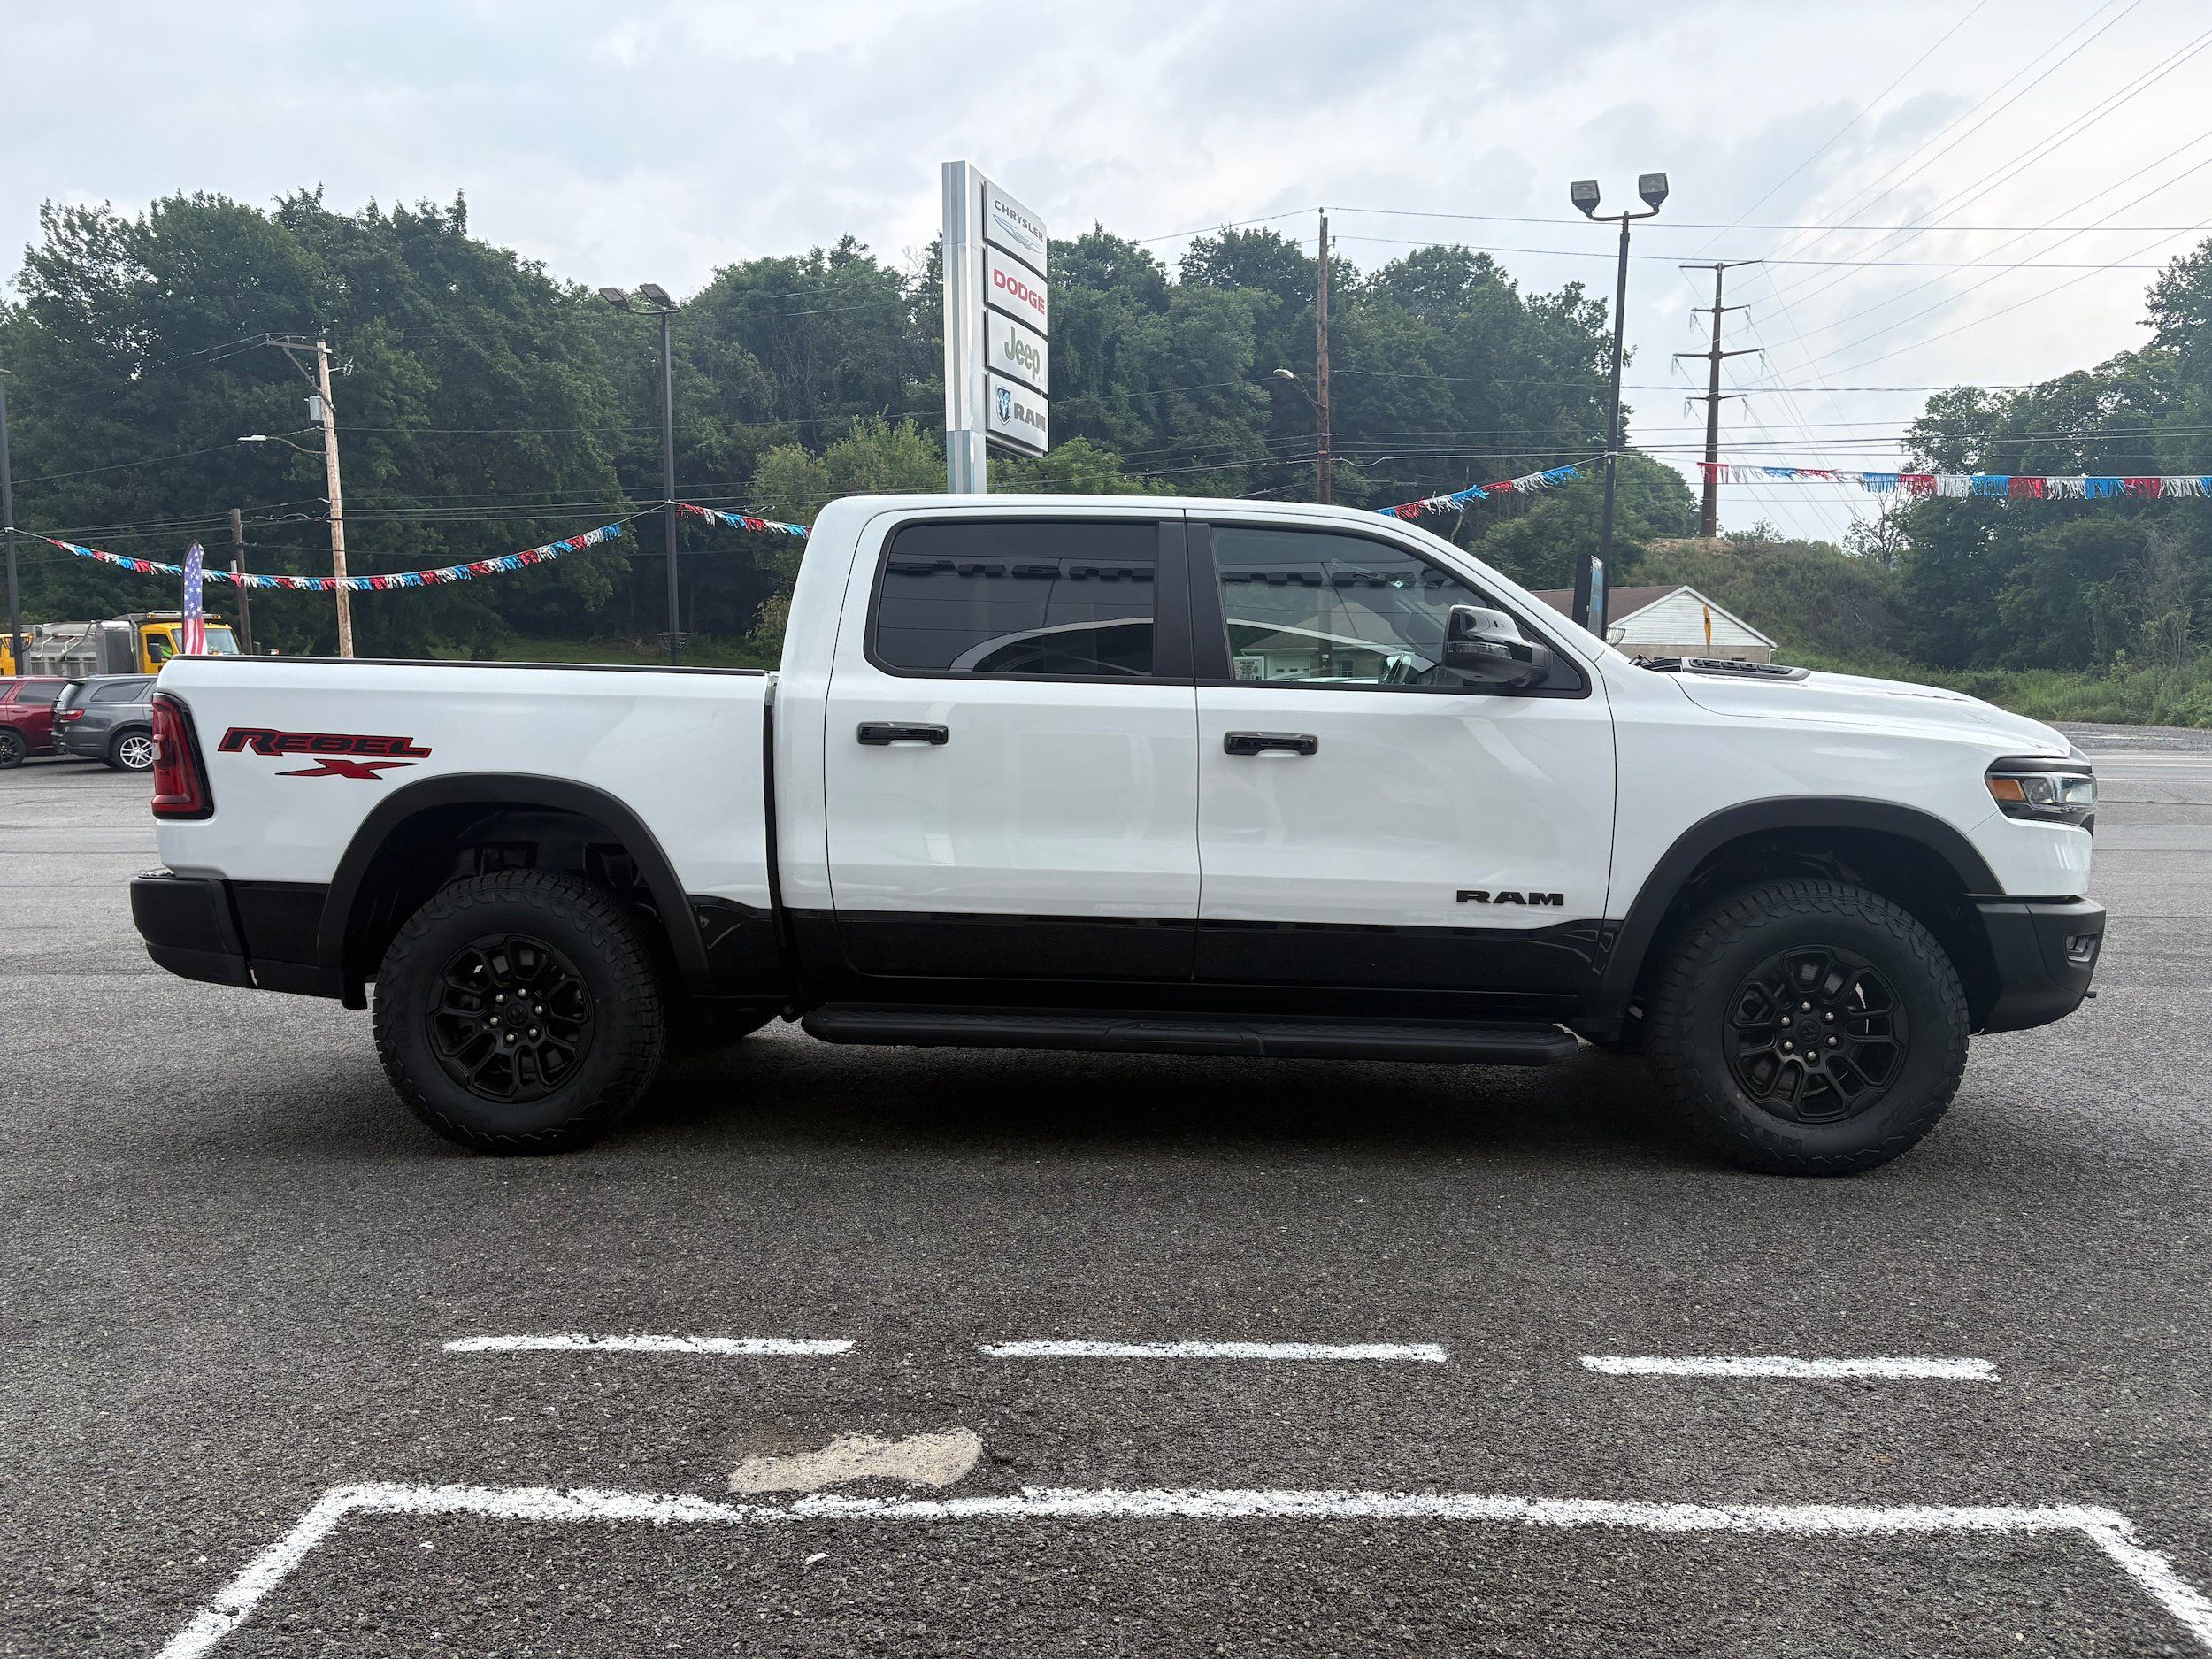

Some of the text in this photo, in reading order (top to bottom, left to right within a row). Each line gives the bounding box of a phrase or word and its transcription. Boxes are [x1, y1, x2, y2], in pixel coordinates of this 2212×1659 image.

[994, 200, 1044, 242] CHRYSLER
[994, 268, 1045, 316] DODGE
[1004, 326, 1041, 380] Jeep
[1013, 402, 1046, 433] RAM
[274, 758, 420, 780] X
[1456, 889, 1565, 907] RAM
